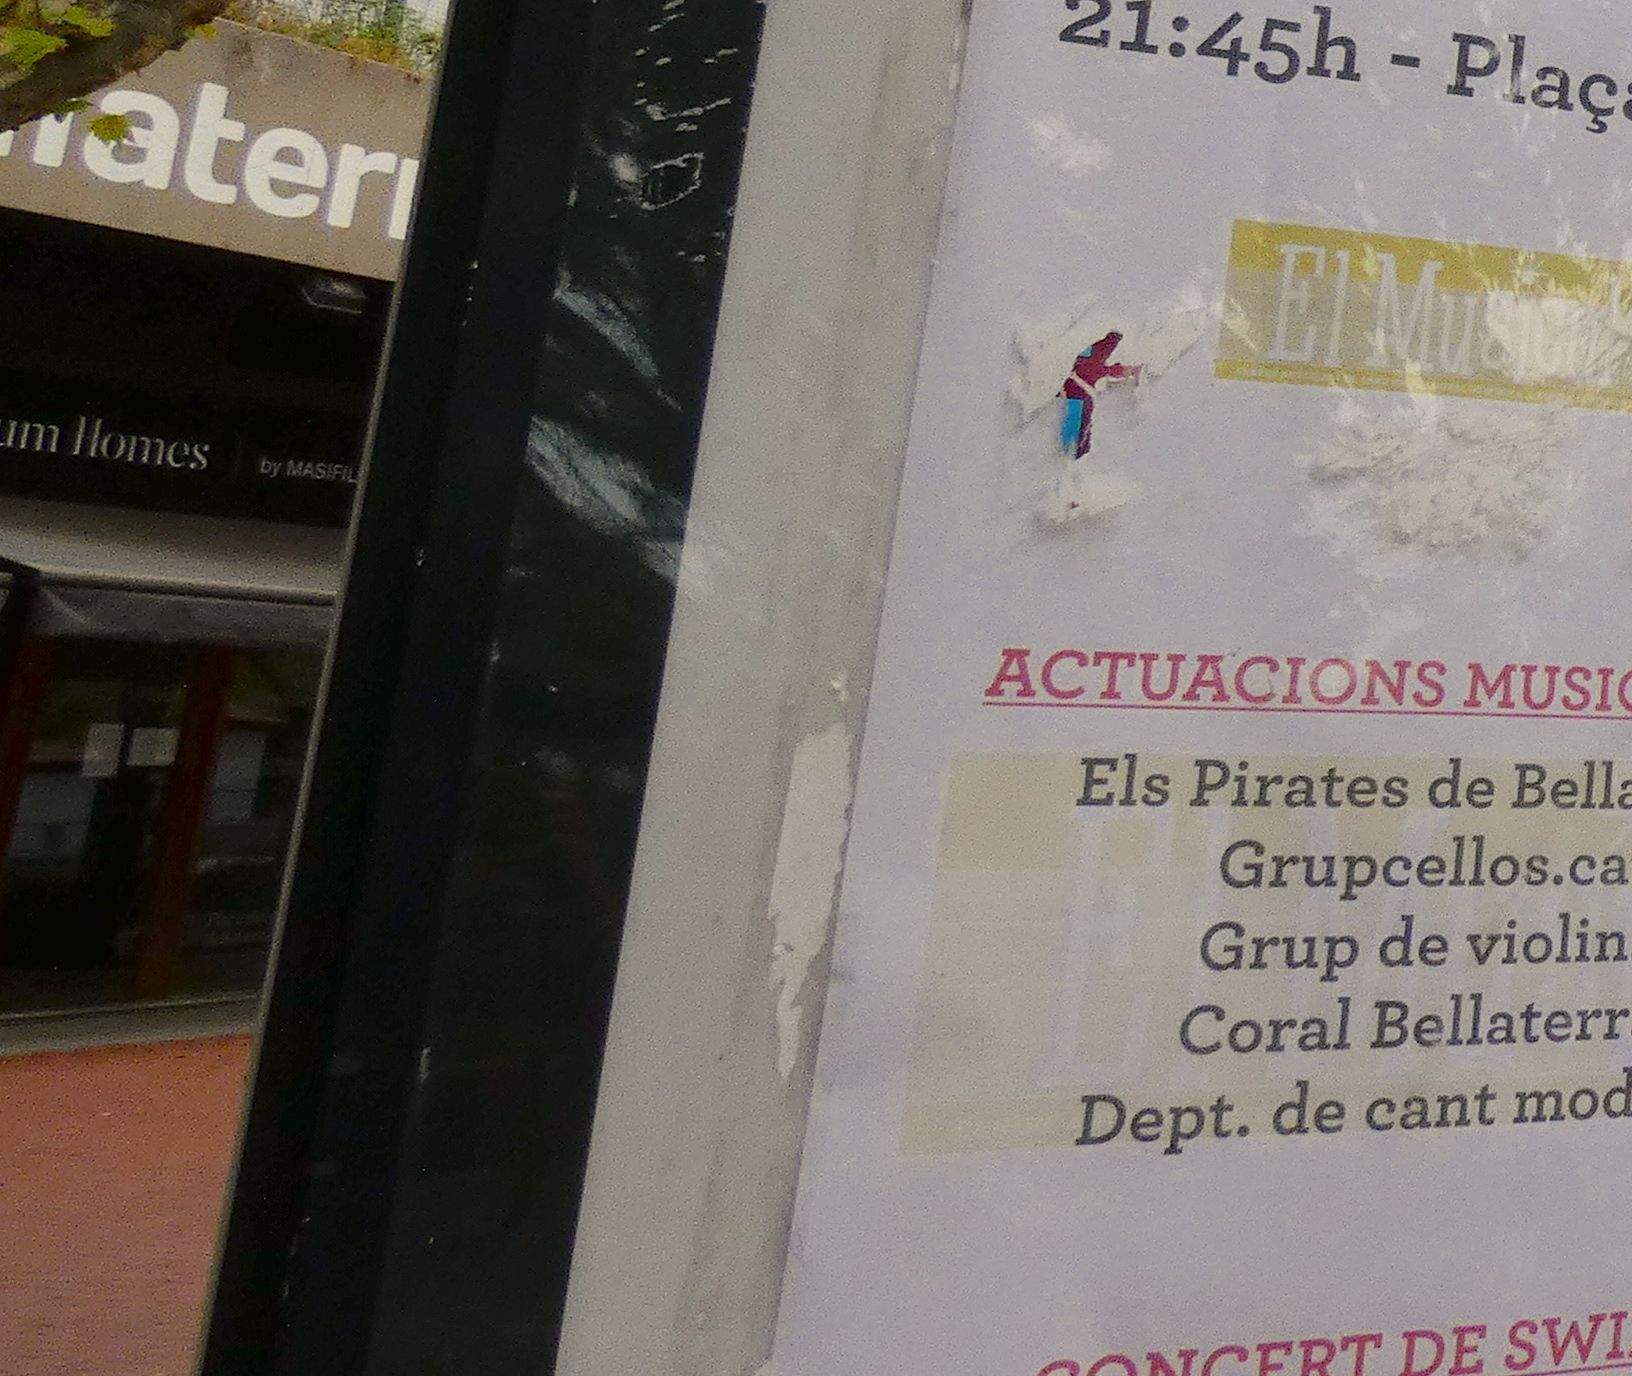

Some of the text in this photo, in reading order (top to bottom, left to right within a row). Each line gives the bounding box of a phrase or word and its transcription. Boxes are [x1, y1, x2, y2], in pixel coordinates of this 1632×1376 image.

[72, 415, 211, 470] Homes
[260, 457, 281, 478] by
[985, 646, 1446, 710] ACTUACIONS
[1077, 757, 1171, 808] Els
[1189, 759, 1410, 809] Pirates
[1427, 758, 1495, 810] de
[1200, 920, 1359, 982] Grup
[1378, 916, 1449, 968] de
[1179, 998, 1352, 1058] Coral
[1076, 1093, 1252, 1155] Dept.
[1271, 1081, 1347, 1136] de
[1364, 1075, 1496, 1131] cant
[1400, 1323, 1488, 1376] DE
